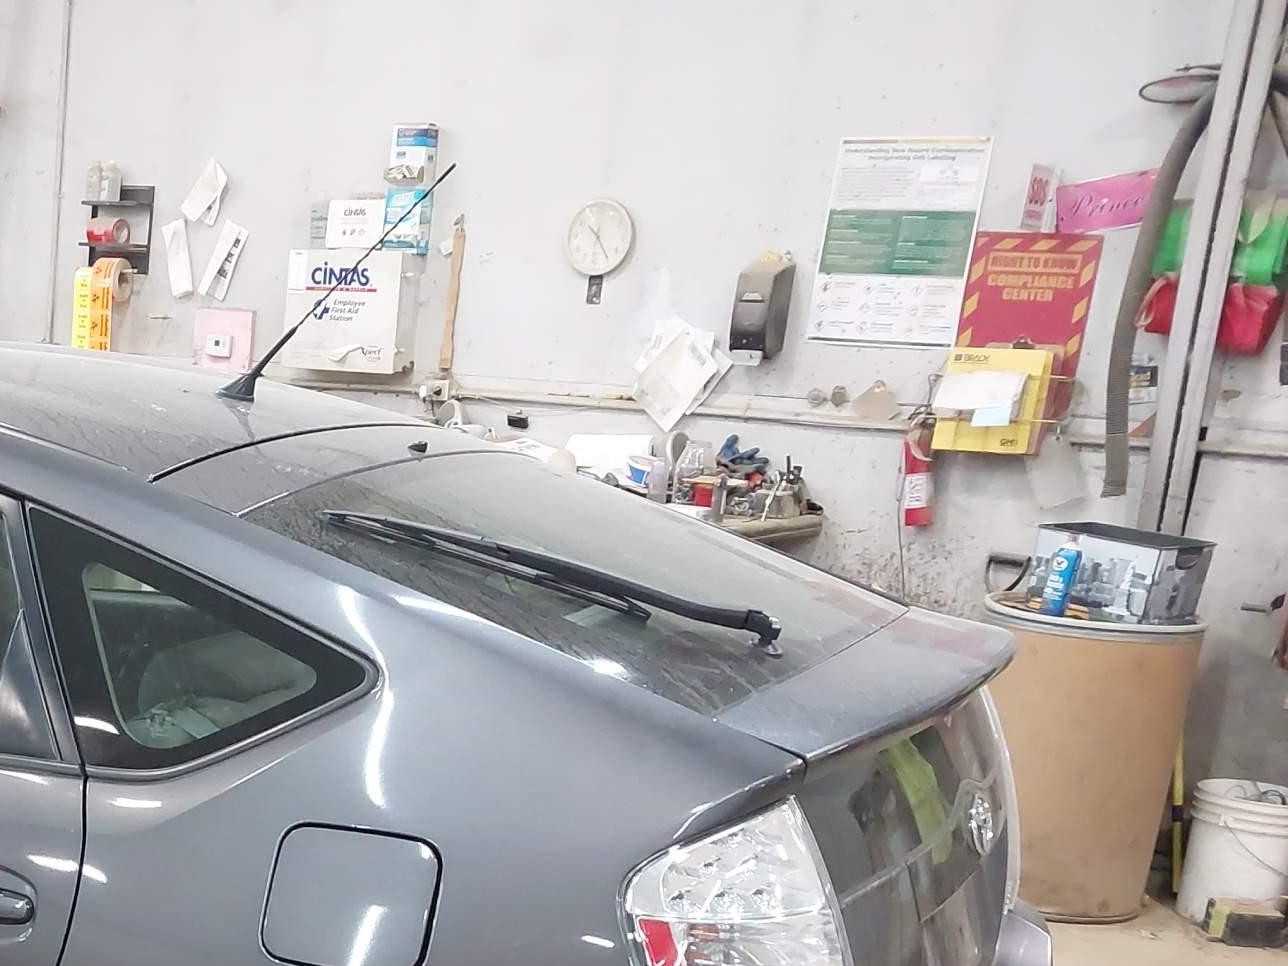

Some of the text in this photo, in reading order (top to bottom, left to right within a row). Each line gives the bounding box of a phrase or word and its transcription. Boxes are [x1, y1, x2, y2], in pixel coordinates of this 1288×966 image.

[987, 273, 1074, 289] COMPLIANCE
[1002, 287, 1054, 302] CENTER
[333, 299, 366, 309] Employee
[330, 306, 346, 314] First
[328, 314, 353, 322] Station
